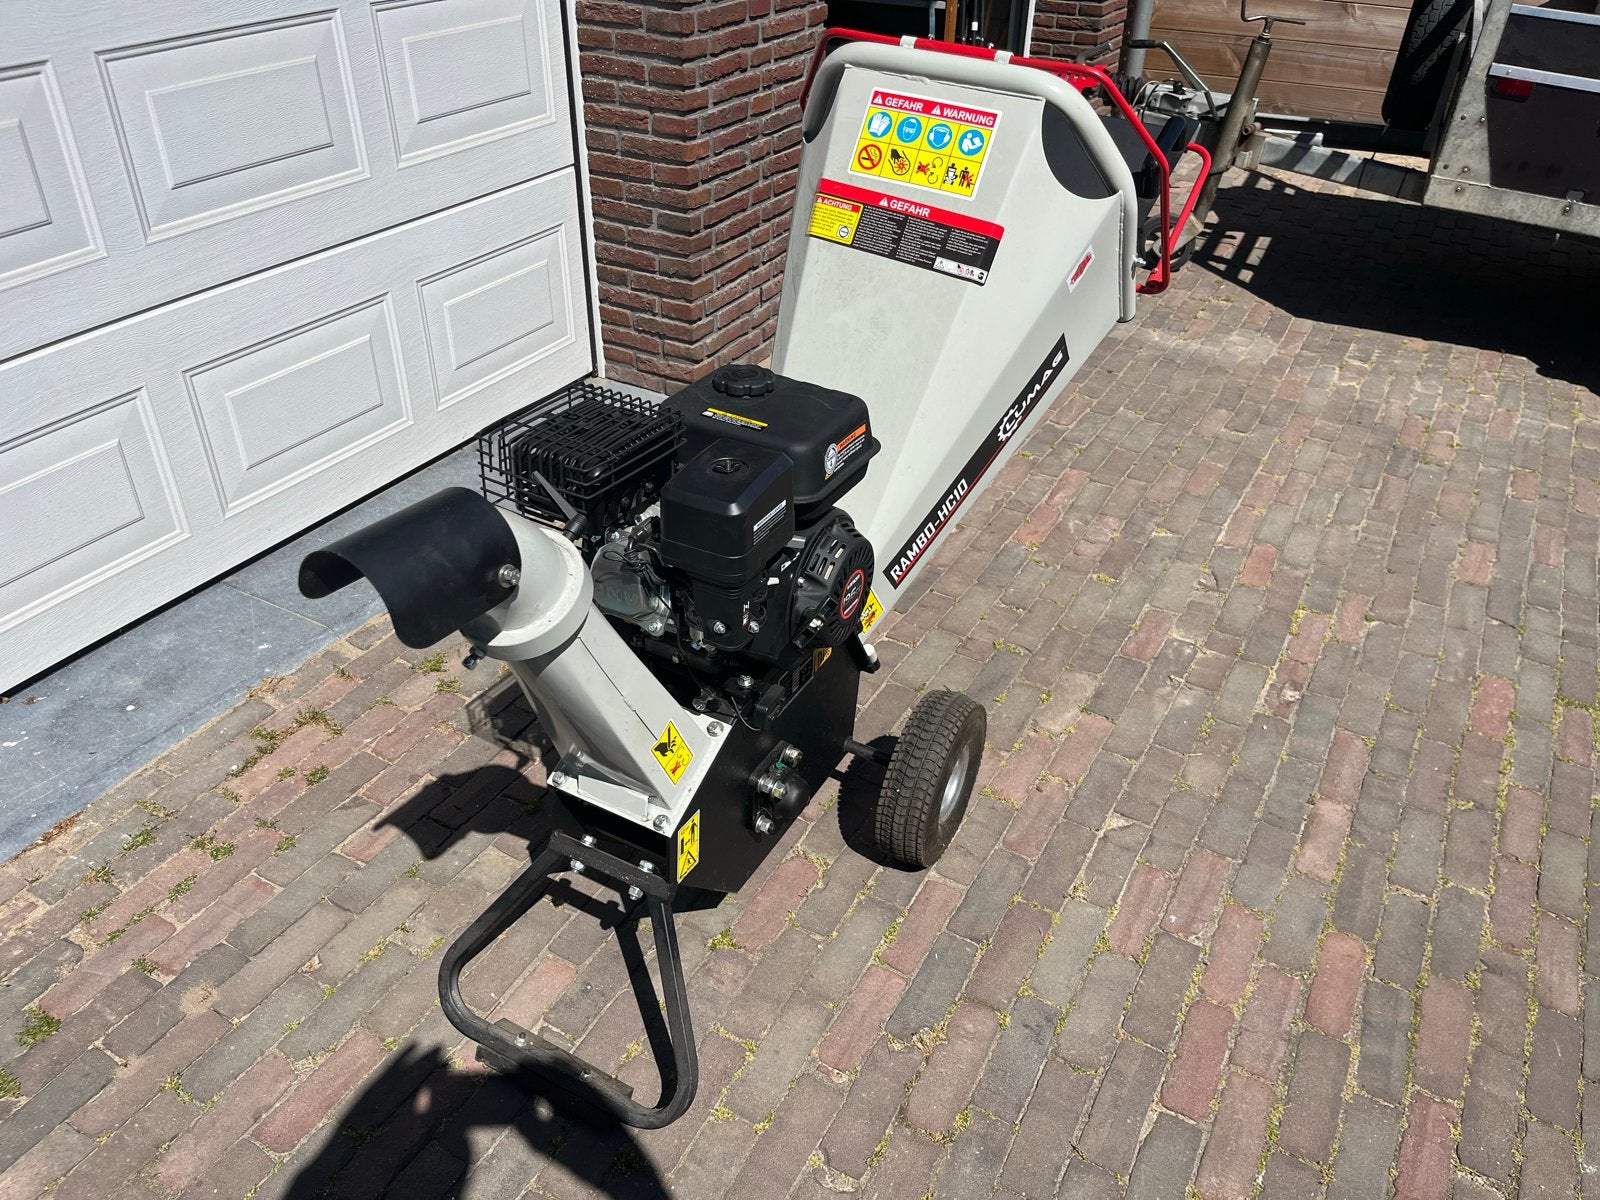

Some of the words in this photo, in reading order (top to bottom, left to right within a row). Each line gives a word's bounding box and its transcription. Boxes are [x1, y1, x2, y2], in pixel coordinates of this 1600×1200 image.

[885, 97, 924, 112] GEFAHR
[943, 107, 994, 126] WARNUNG
[823, 198, 853, 211] ACHTUNG
[889, 199, 931, 218] GEFAHR
[890, 478, 969, 582] RAMBO-HC10
